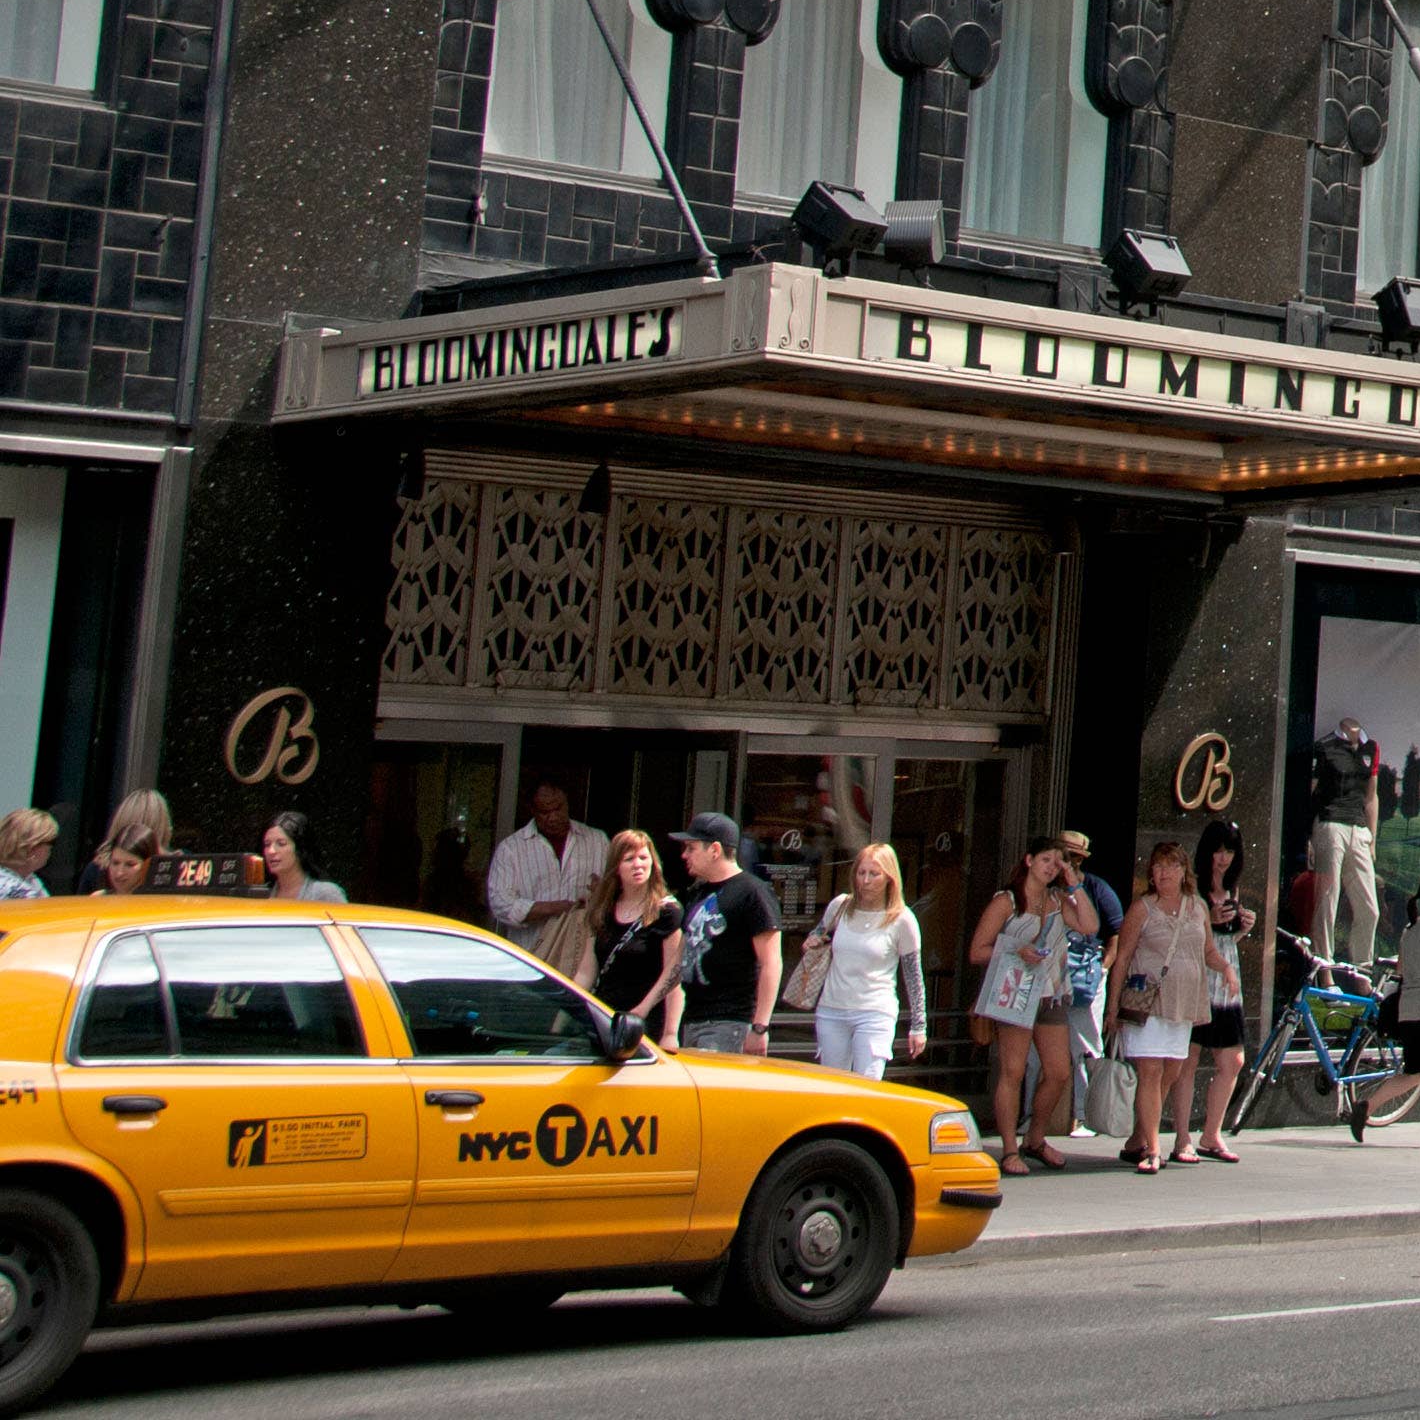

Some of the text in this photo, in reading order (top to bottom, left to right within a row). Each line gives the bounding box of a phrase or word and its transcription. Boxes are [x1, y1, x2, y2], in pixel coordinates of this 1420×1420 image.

[373, 306, 676, 392] BLOOMINGDALE'S
[177, 860, 213, 887] 2E49
[458, 1103, 659, 1167] NYC TAXI
